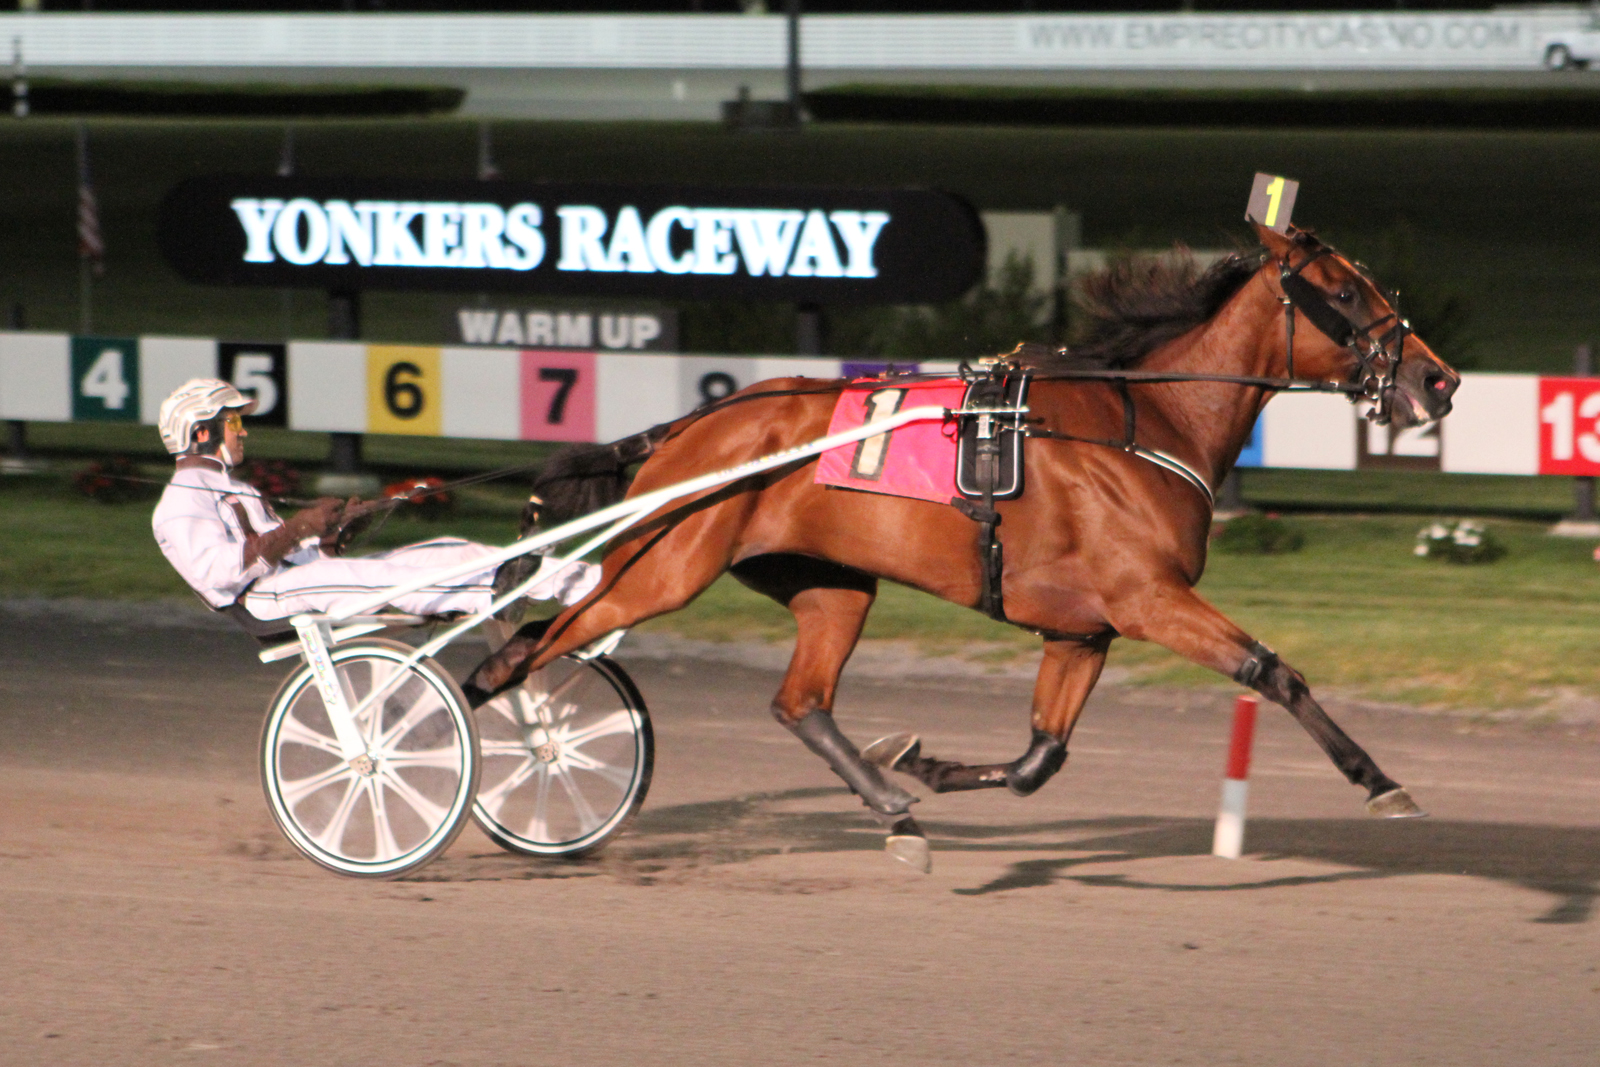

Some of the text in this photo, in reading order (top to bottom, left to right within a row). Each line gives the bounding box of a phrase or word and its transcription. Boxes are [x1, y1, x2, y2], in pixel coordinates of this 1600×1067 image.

[1265, 176, 1285, 227] 1
[231, 198, 891, 278] YONKERS RACEWAY
[458, 310, 662, 349] WARM UP
[81, 348, 130, 411] 4
[232, 352, 276, 416] 5
[382, 361, 426, 420] 6
[538, 367, 579, 424] 7
[852, 389, 906, 478] 1
